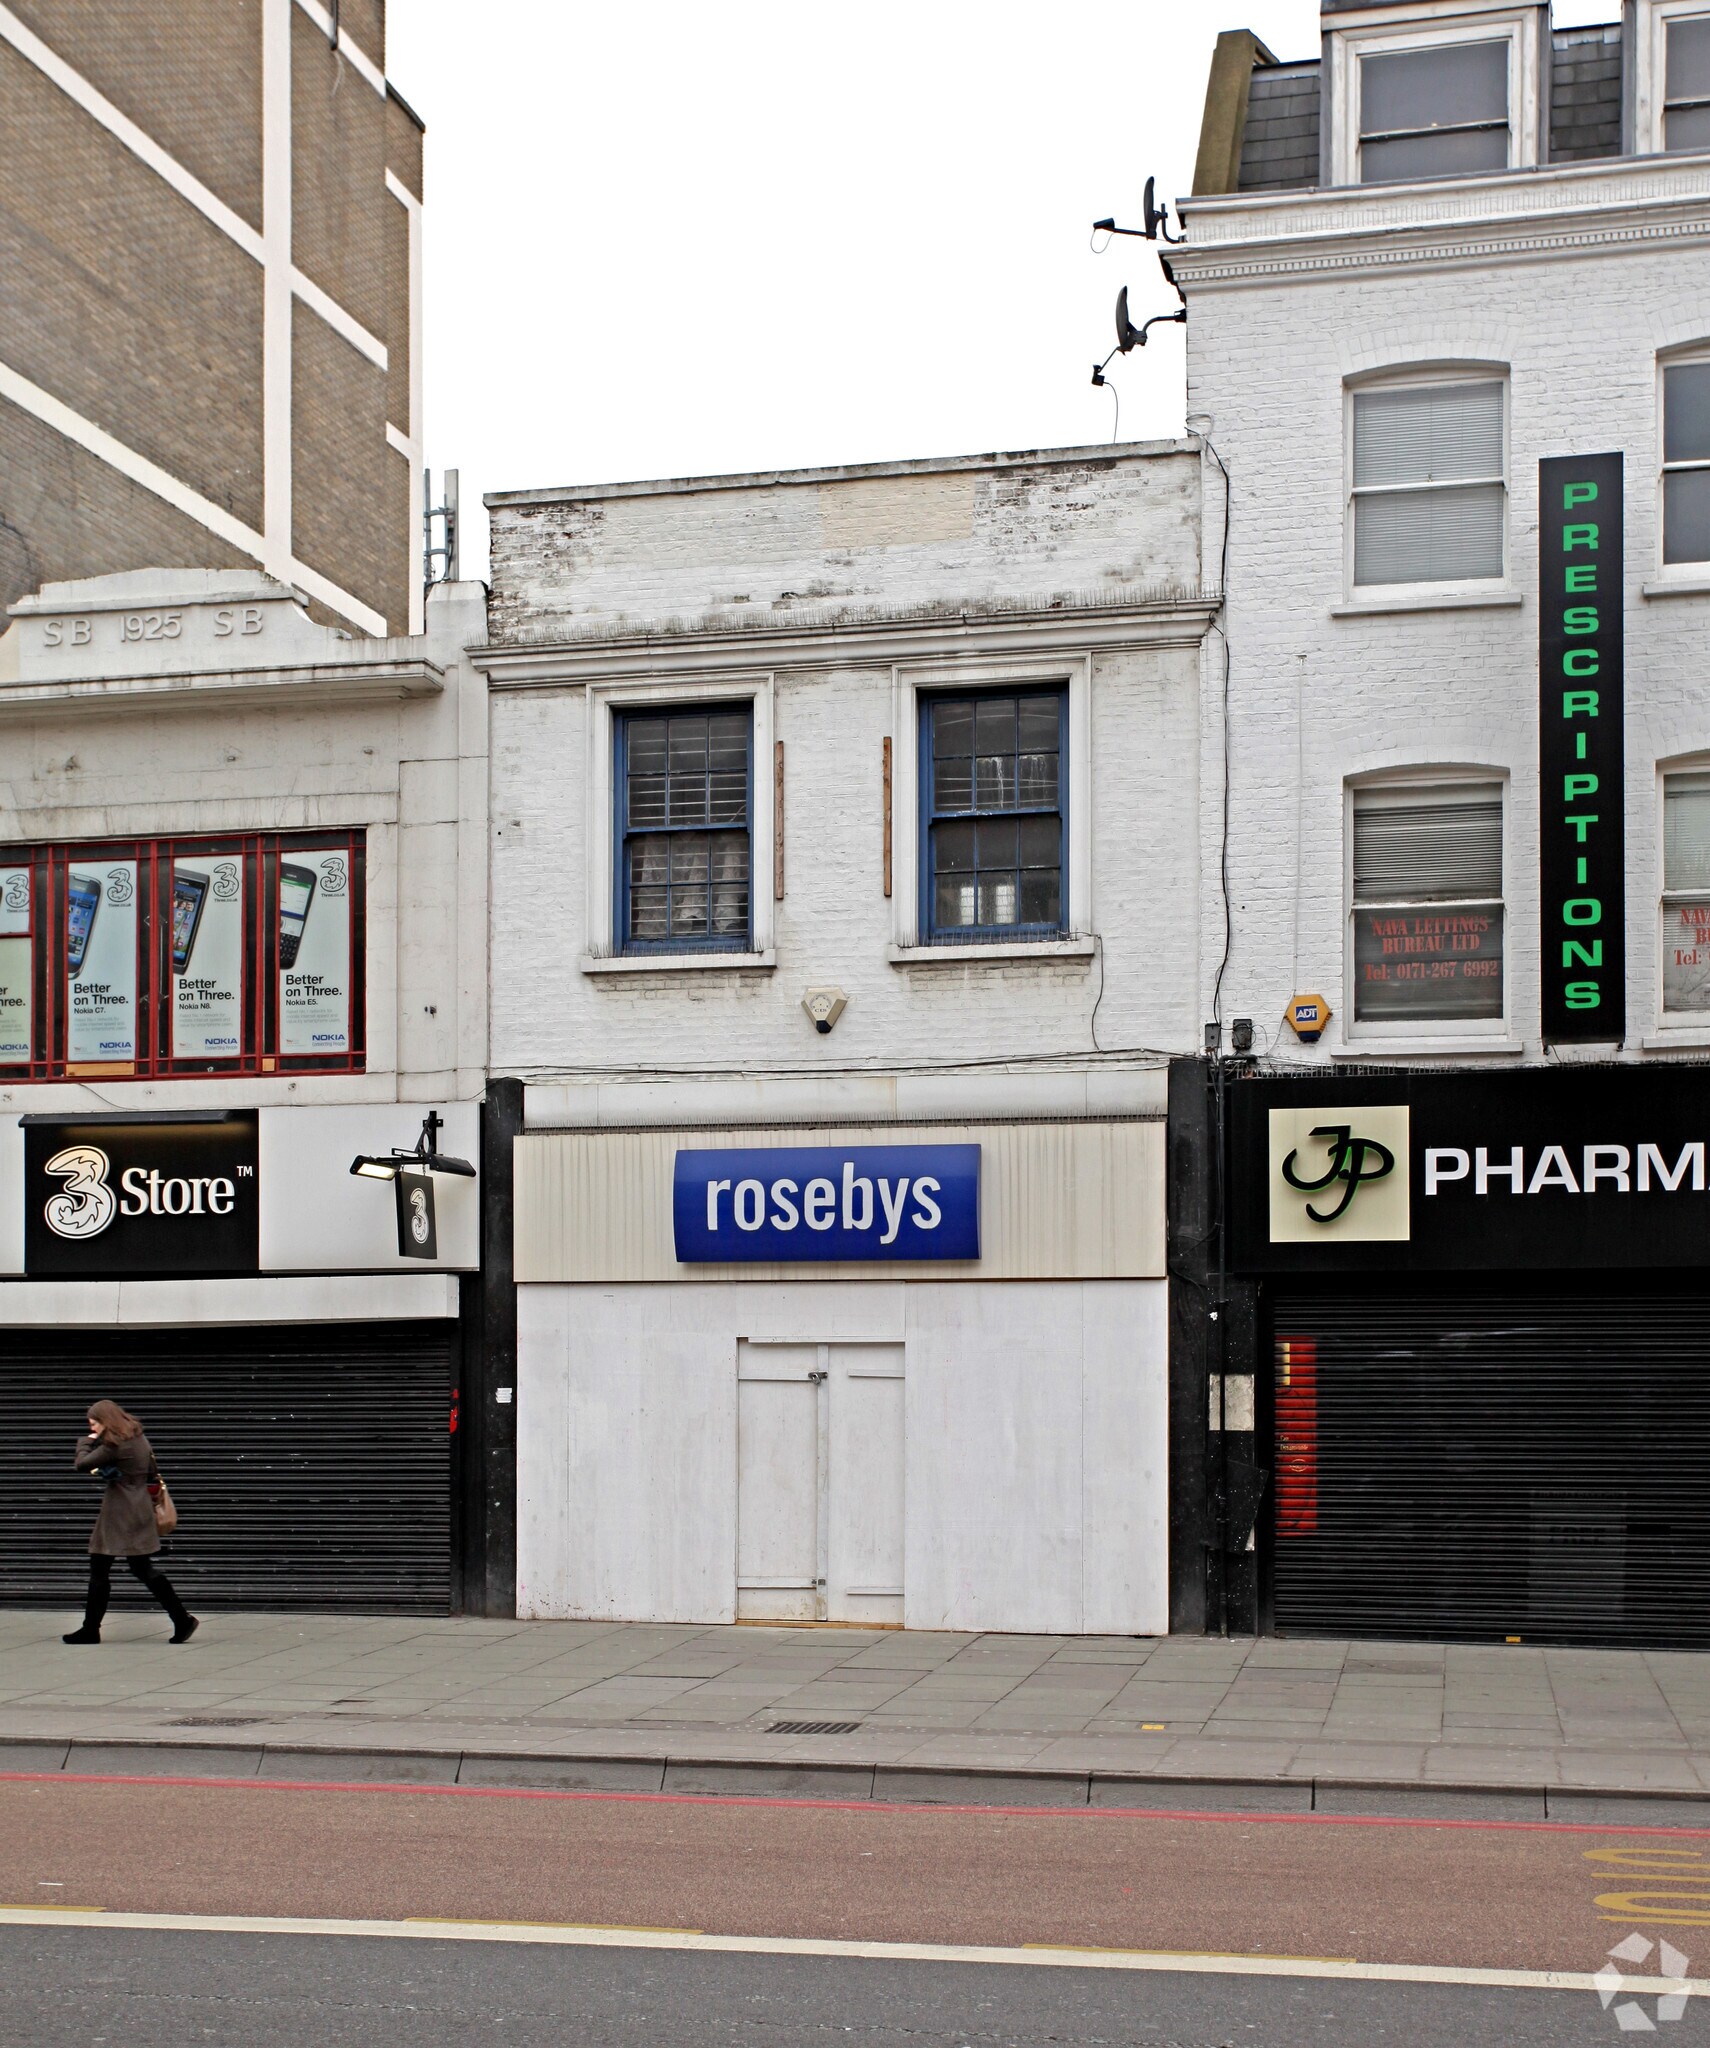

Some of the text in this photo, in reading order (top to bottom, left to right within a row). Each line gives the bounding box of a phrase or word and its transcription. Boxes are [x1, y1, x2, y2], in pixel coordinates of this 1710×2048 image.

[120, 613, 183, 643] 1925
[1562, 481, 1603, 1010] PRESCRIPTIONS
[1372, 914, 1489, 936] NAVA LETTINGS
[1382, 934, 1480, 955] BUREAU LTD
[1674, 949, 1702, 966] Tel:
[1364, 959, 1498, 981] Tel: 0171-267 6992
[179, 979, 216, 989] Better
[286, 974, 324, 985] Better
[74, 983, 111, 994] Better
[179, 990, 235, 1001] on Three.
[285, 985, 342, 997] on Three.
[74, 994, 129, 1006] on Three.
[1296, 1008, 1317, 1019] ADT
[45, 1145, 116, 1239] 3
[120, 1167, 235, 1215] Store
[707, 1162, 942, 1244] rosebys
